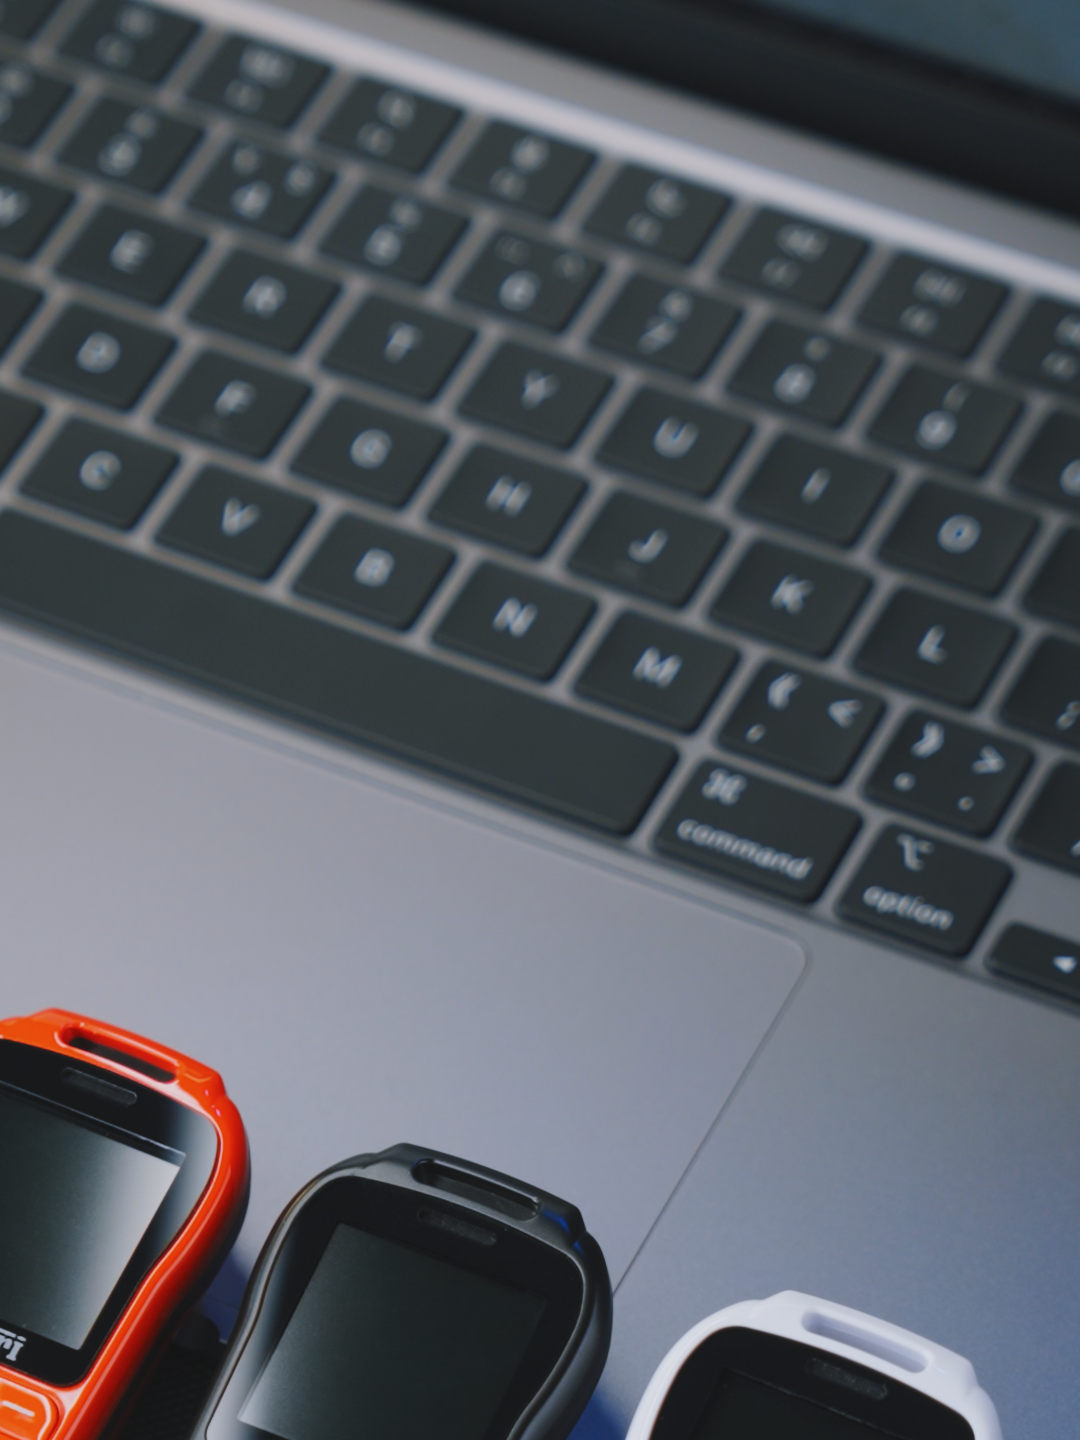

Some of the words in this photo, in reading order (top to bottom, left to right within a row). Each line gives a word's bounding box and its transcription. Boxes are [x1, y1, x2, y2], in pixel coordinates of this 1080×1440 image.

[653, 418, 698, 457] U
[486, 477, 530, 513] H
[222, 497, 259, 535] V
[937, 515, 980, 552] O
[628, 530, 667, 563] J
[771, 575, 813, 614] K
[493, 598, 536, 636] N
[919, 624, 947, 663] L
[633, 648, 681, 685] M
[678, 819, 813, 880] command
[863, 886, 954, 929] option
